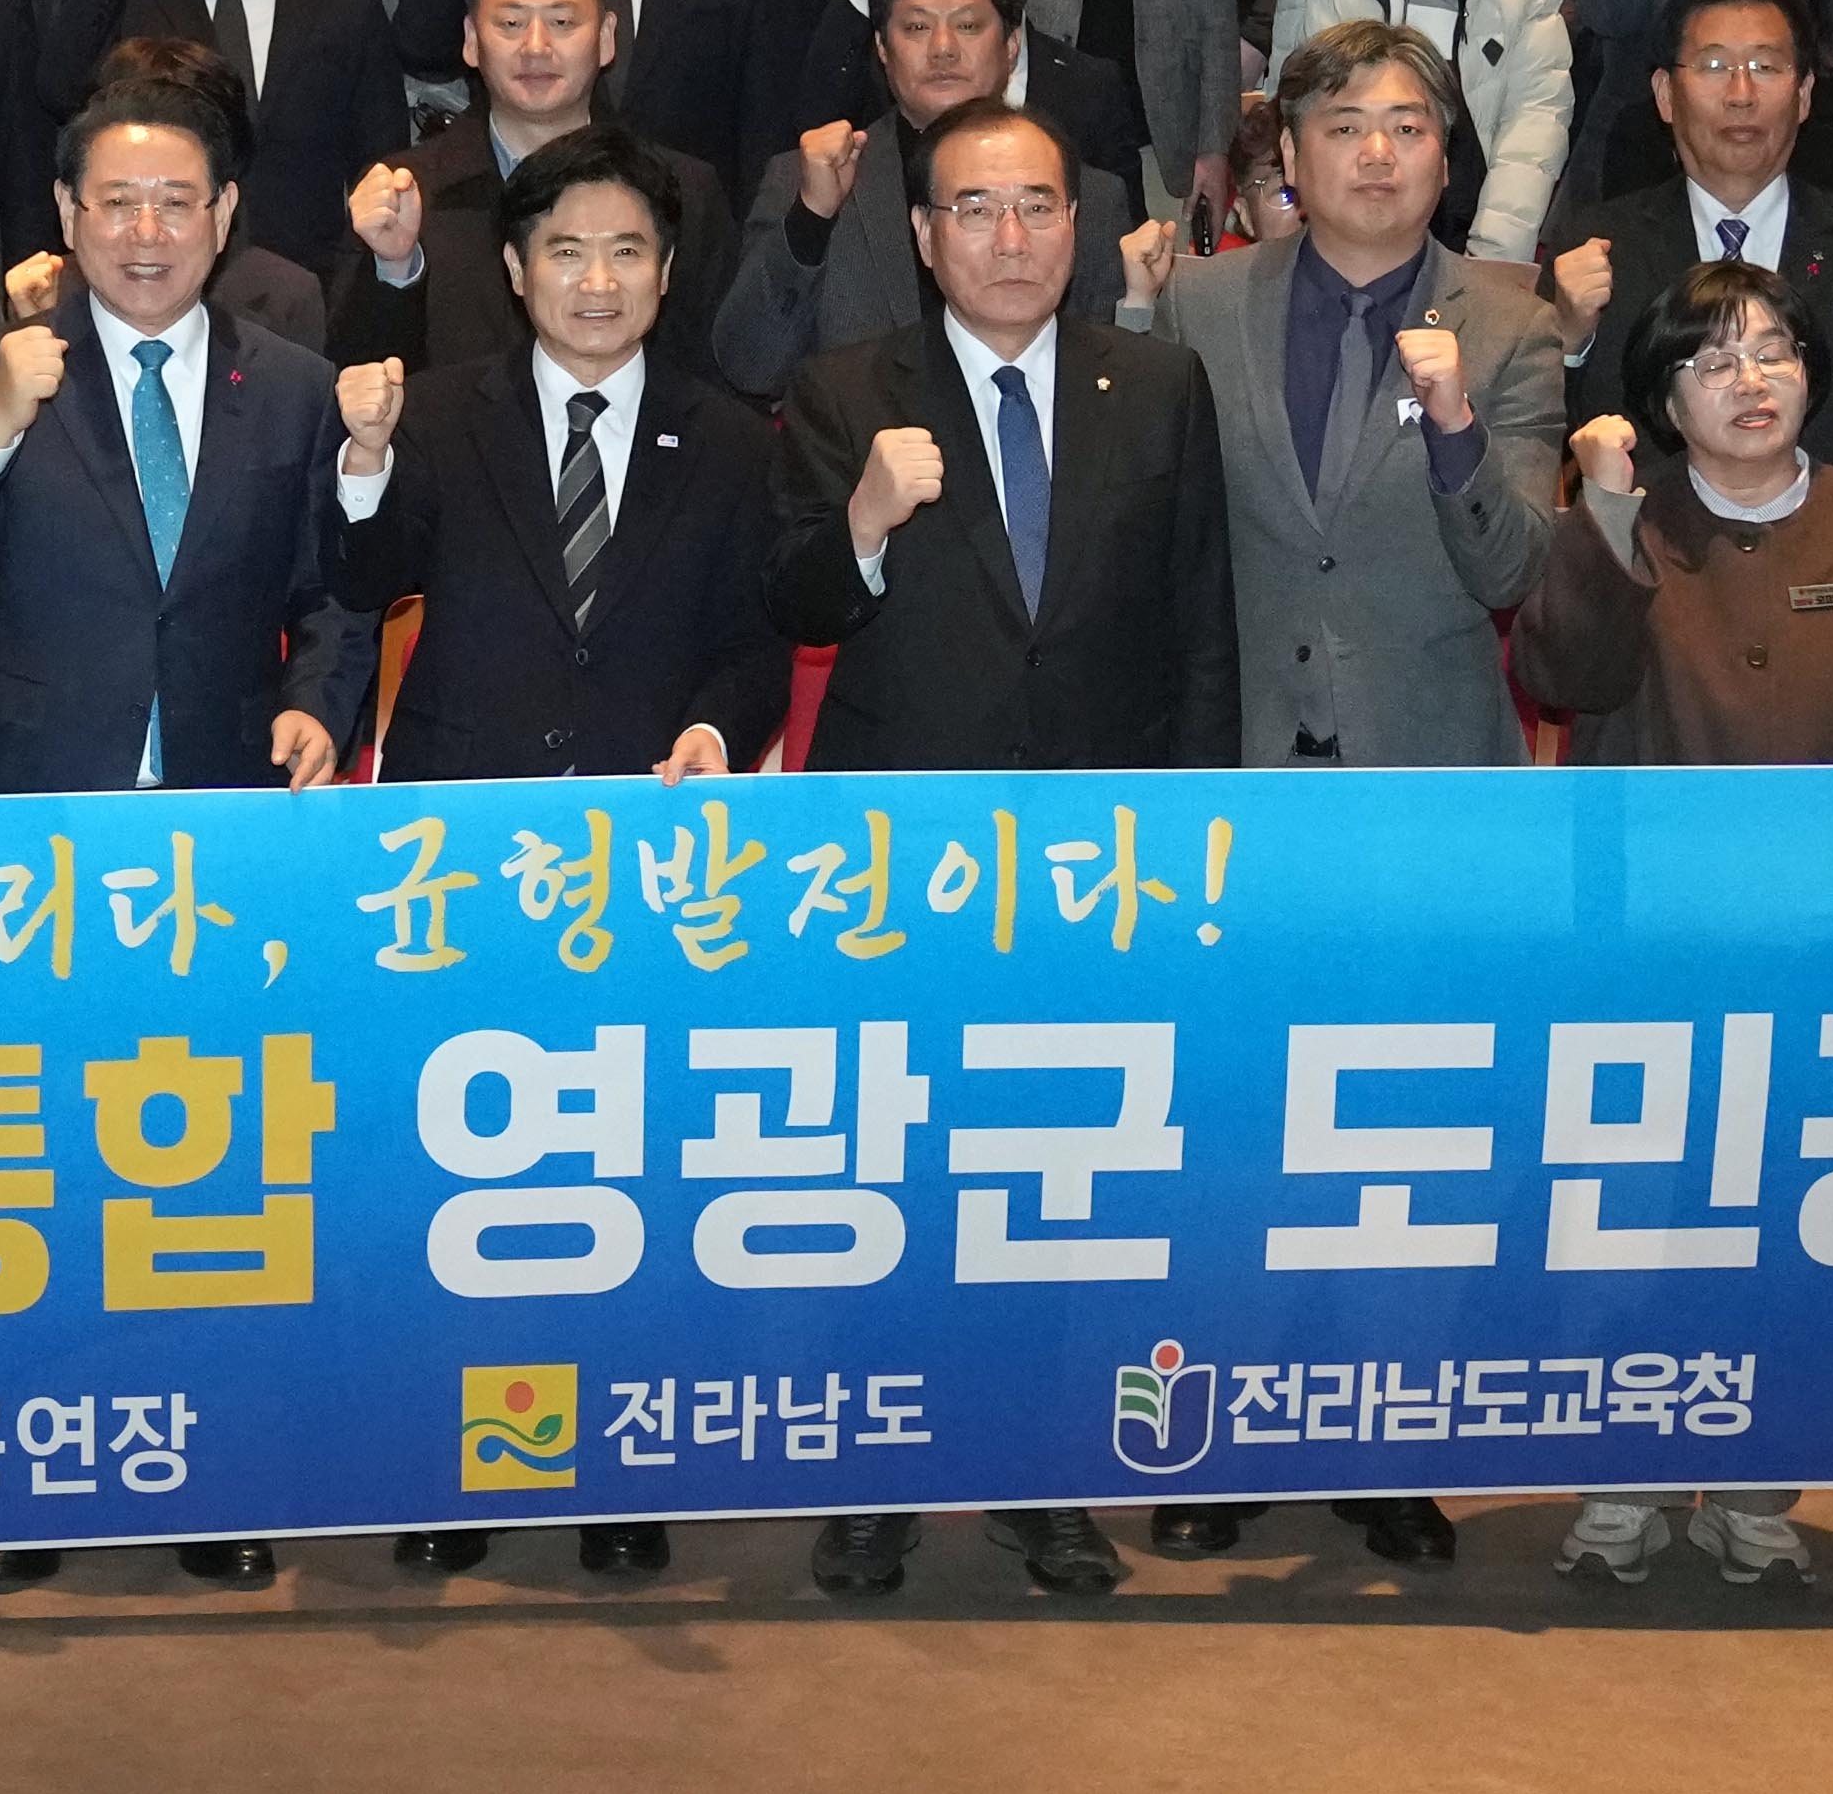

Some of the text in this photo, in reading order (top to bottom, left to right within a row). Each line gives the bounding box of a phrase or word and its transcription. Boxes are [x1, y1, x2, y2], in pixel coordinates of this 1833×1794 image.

[355, 799, 1234, 974] 균형발전이다!
[416, 1019, 1185, 1299] 영광군
[603, 1371, 933, 1467] 전라남도
[1226, 1351, 1757, 1445] 전라남도교육청
